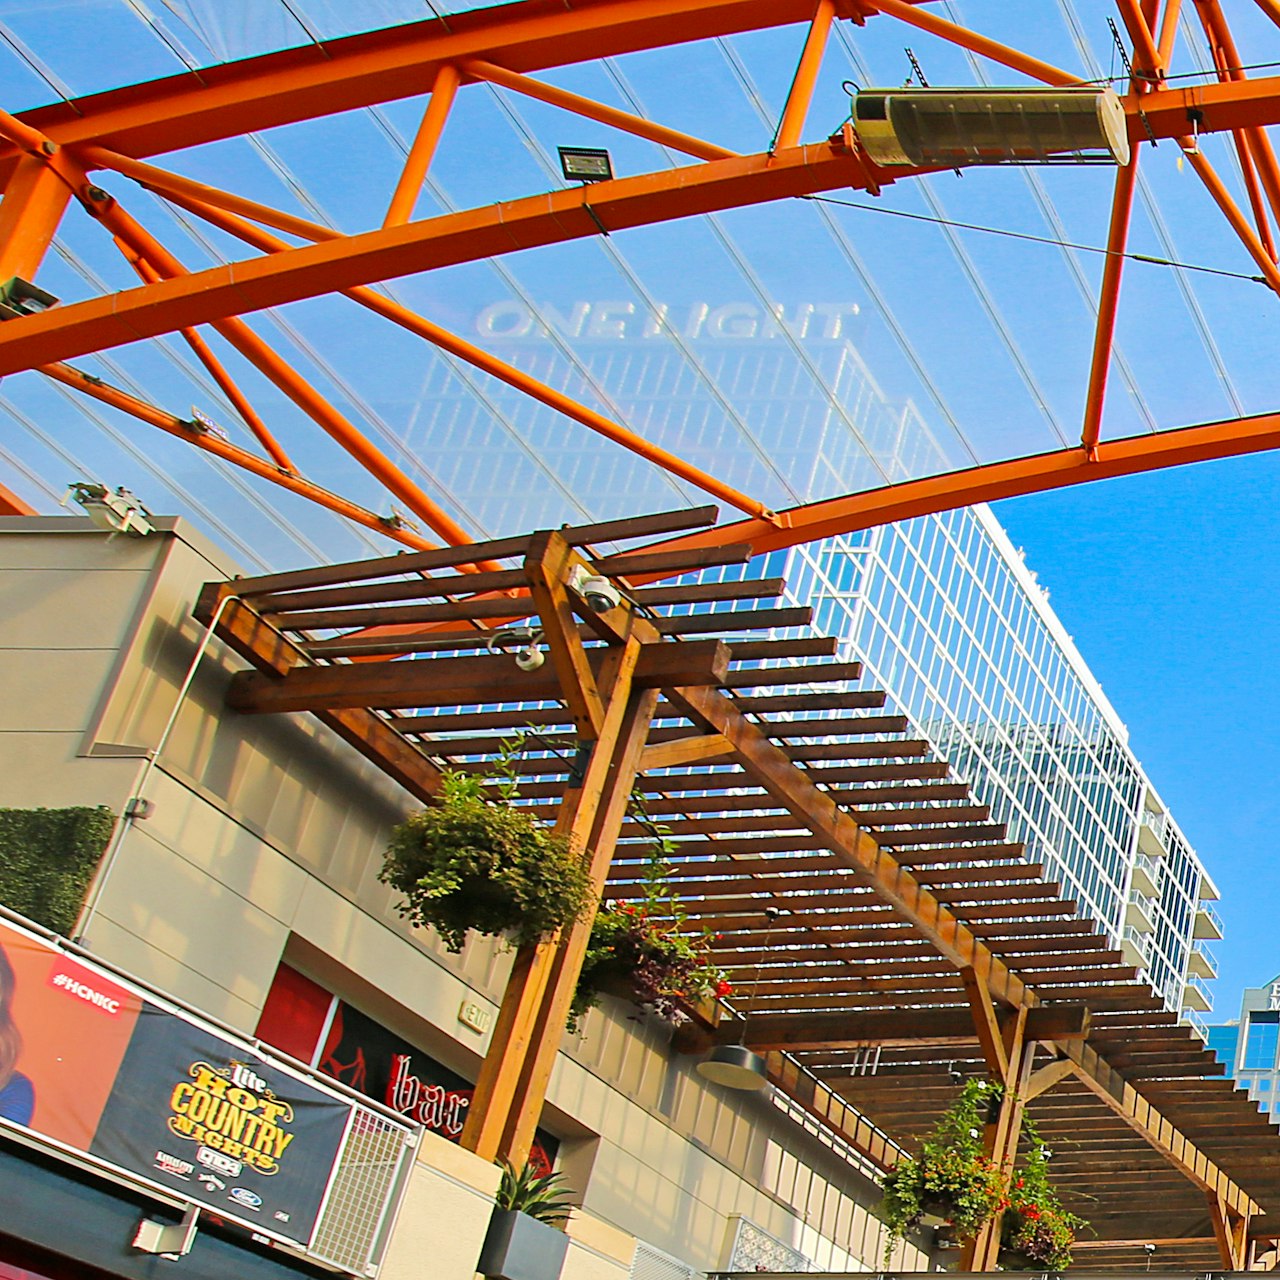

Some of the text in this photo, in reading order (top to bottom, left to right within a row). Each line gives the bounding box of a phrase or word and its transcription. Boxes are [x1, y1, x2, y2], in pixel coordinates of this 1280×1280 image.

[476, 301, 860, 339] ONE LIGHT
[52, 974, 120, 1014] #HCNKC
[192, 1066, 288, 1126] HOT
[230, 1064, 267, 1093] Lite
[390, 1054, 469, 1135] bar
[170, 1082, 294, 1159] COUNTRY
[174, 1114, 275, 1170] NIGHTS
